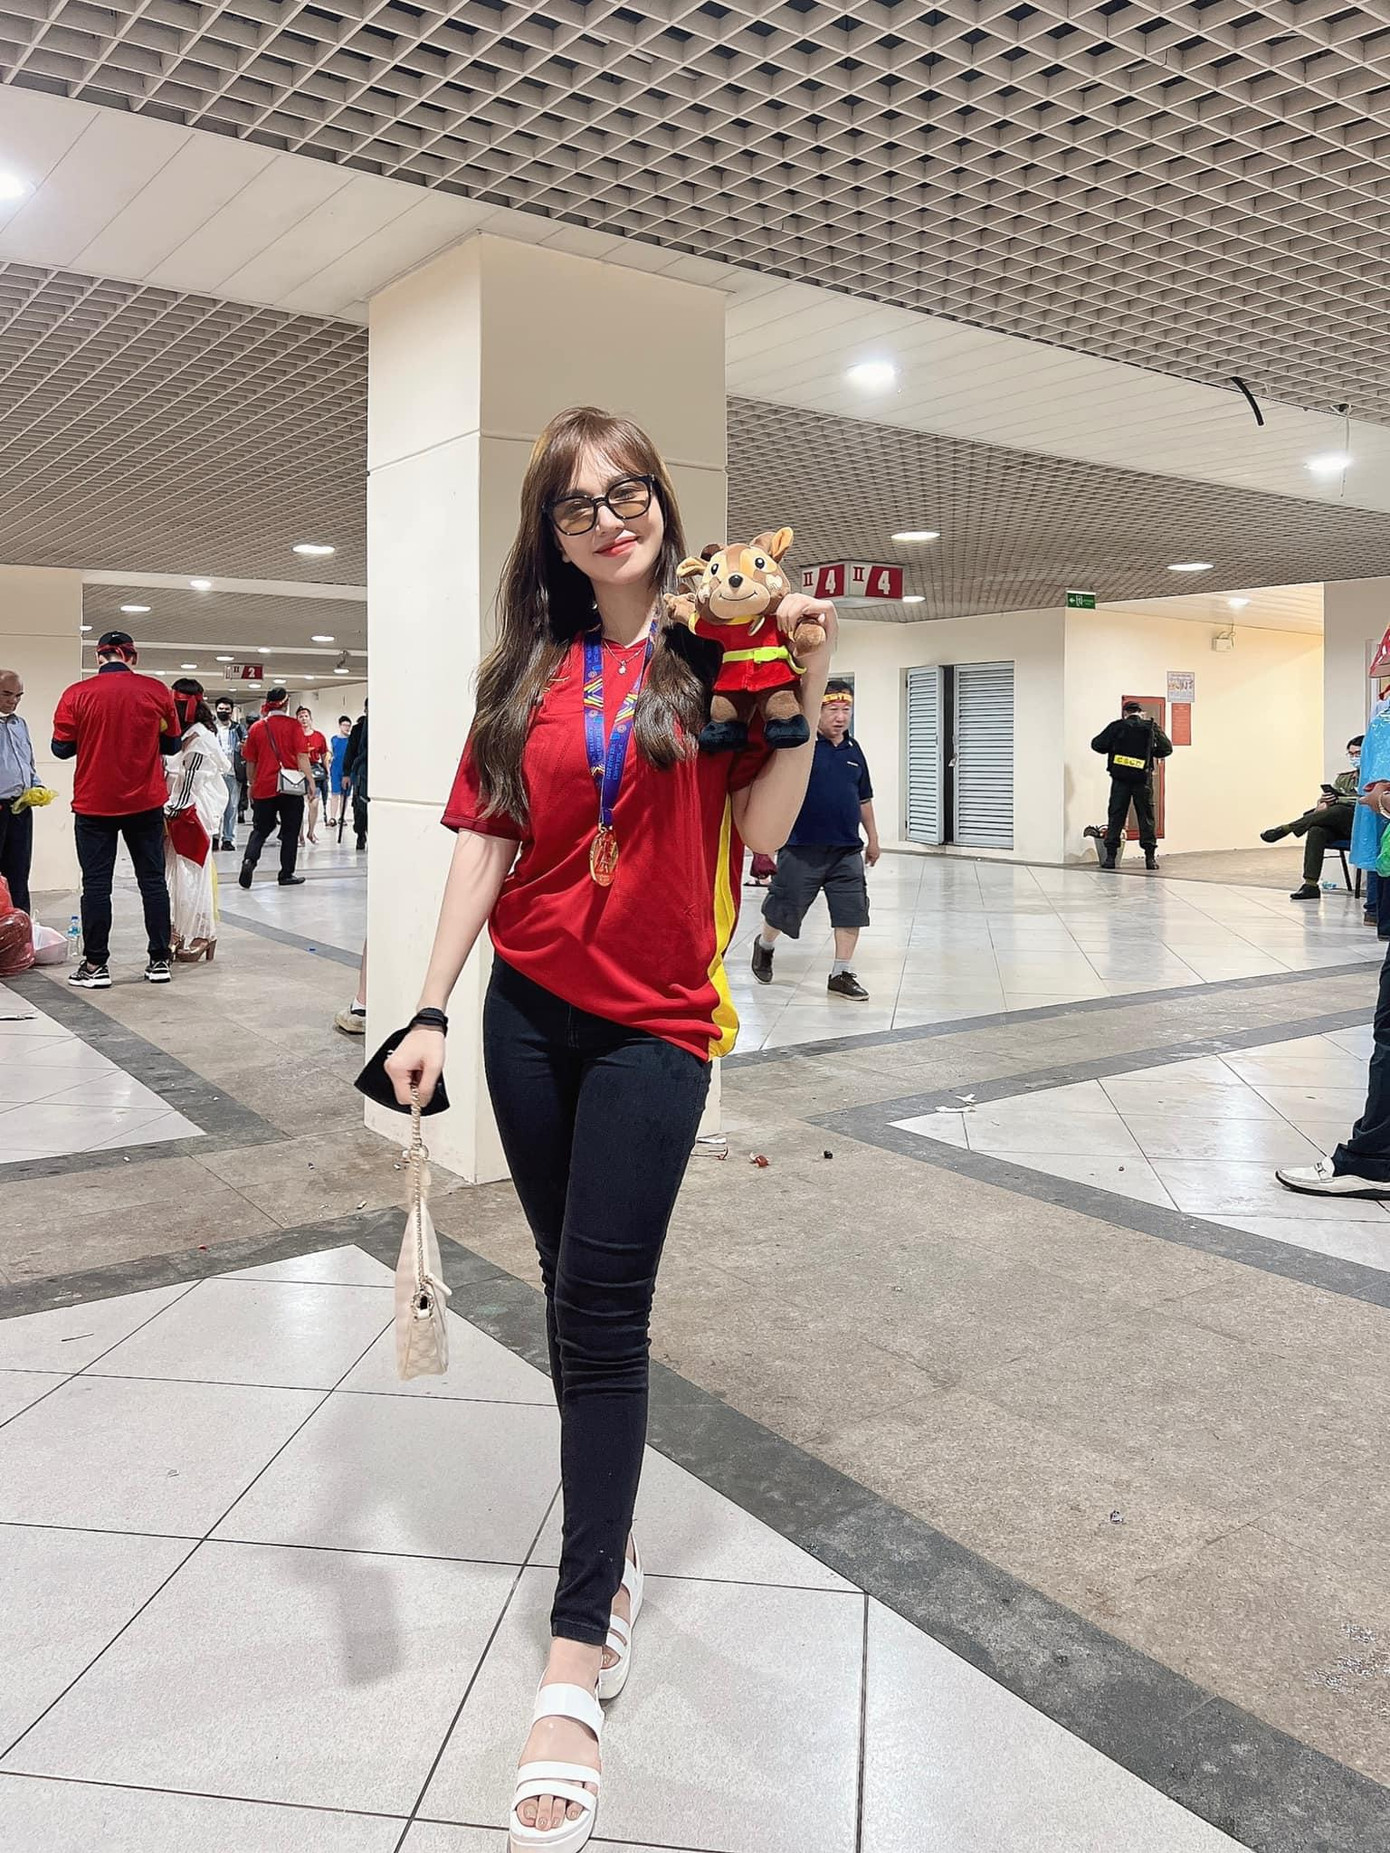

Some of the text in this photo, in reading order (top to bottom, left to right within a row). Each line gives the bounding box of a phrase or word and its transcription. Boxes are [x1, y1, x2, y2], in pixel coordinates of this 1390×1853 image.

[803, 569, 836, 594] II 4
[853, 566, 891, 595] II 4
[248, 667, 255, 678] 2
